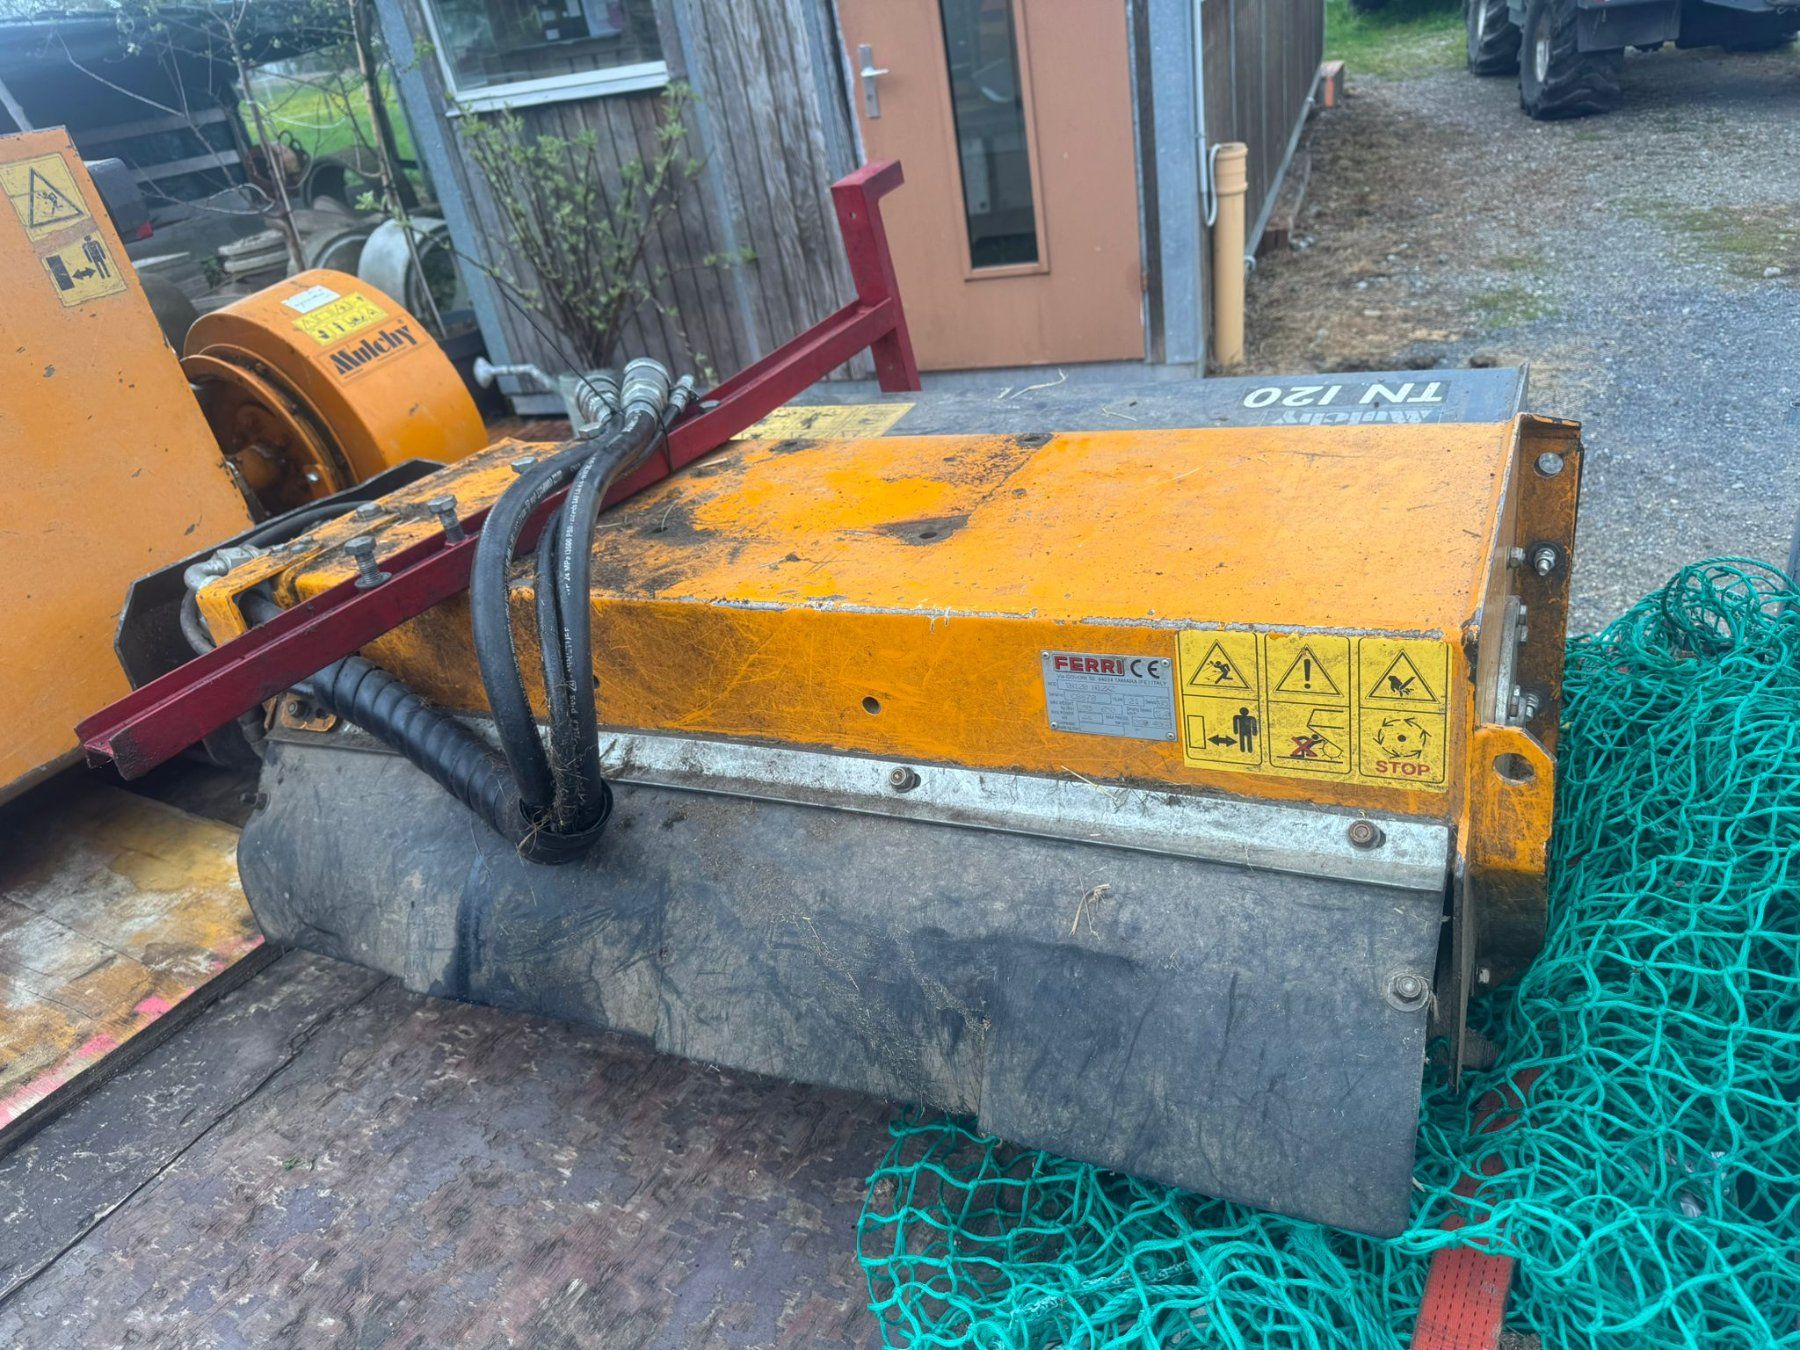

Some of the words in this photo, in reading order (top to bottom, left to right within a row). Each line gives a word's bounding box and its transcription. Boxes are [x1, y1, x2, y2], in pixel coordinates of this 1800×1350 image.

[330, 325, 417, 375] Mulchy
[1243, 384, 1342, 408] 120
[1359, 382, 1444, 405] TN
[1054, 655, 1123, 675] FERRI
[1376, 760, 1431, 776] STOP
